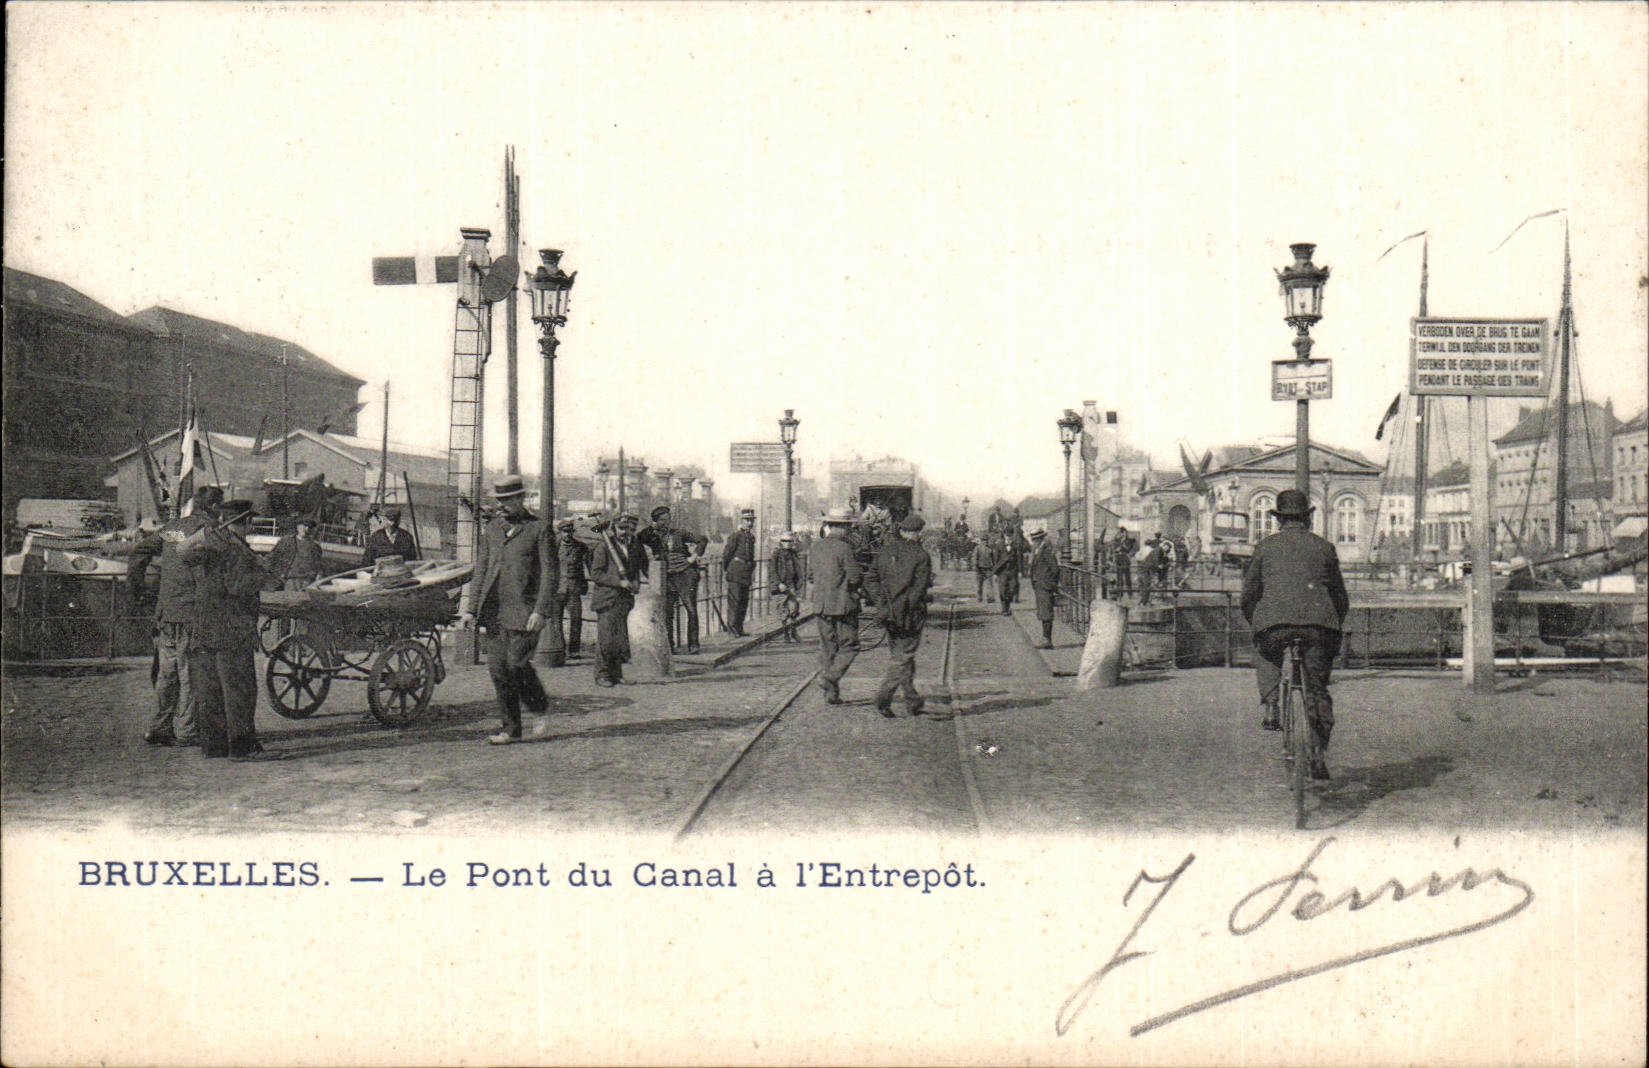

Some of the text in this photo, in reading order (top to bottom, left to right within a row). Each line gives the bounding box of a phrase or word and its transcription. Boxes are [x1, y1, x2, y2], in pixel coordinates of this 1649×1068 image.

[1418, 326, 1540, 338] VERBODEN OVER DE BRUG TE GAAN
[1418, 342, 1540, 354] TERWIJL DEN DOORGANG DER TREINEN
[1417, 359, 1540, 371] DEFENSE DE CIRCULER SUR LE PONT
[1418, 374, 1540, 387] PENDANT LE PASSAGE DES TRAINS
